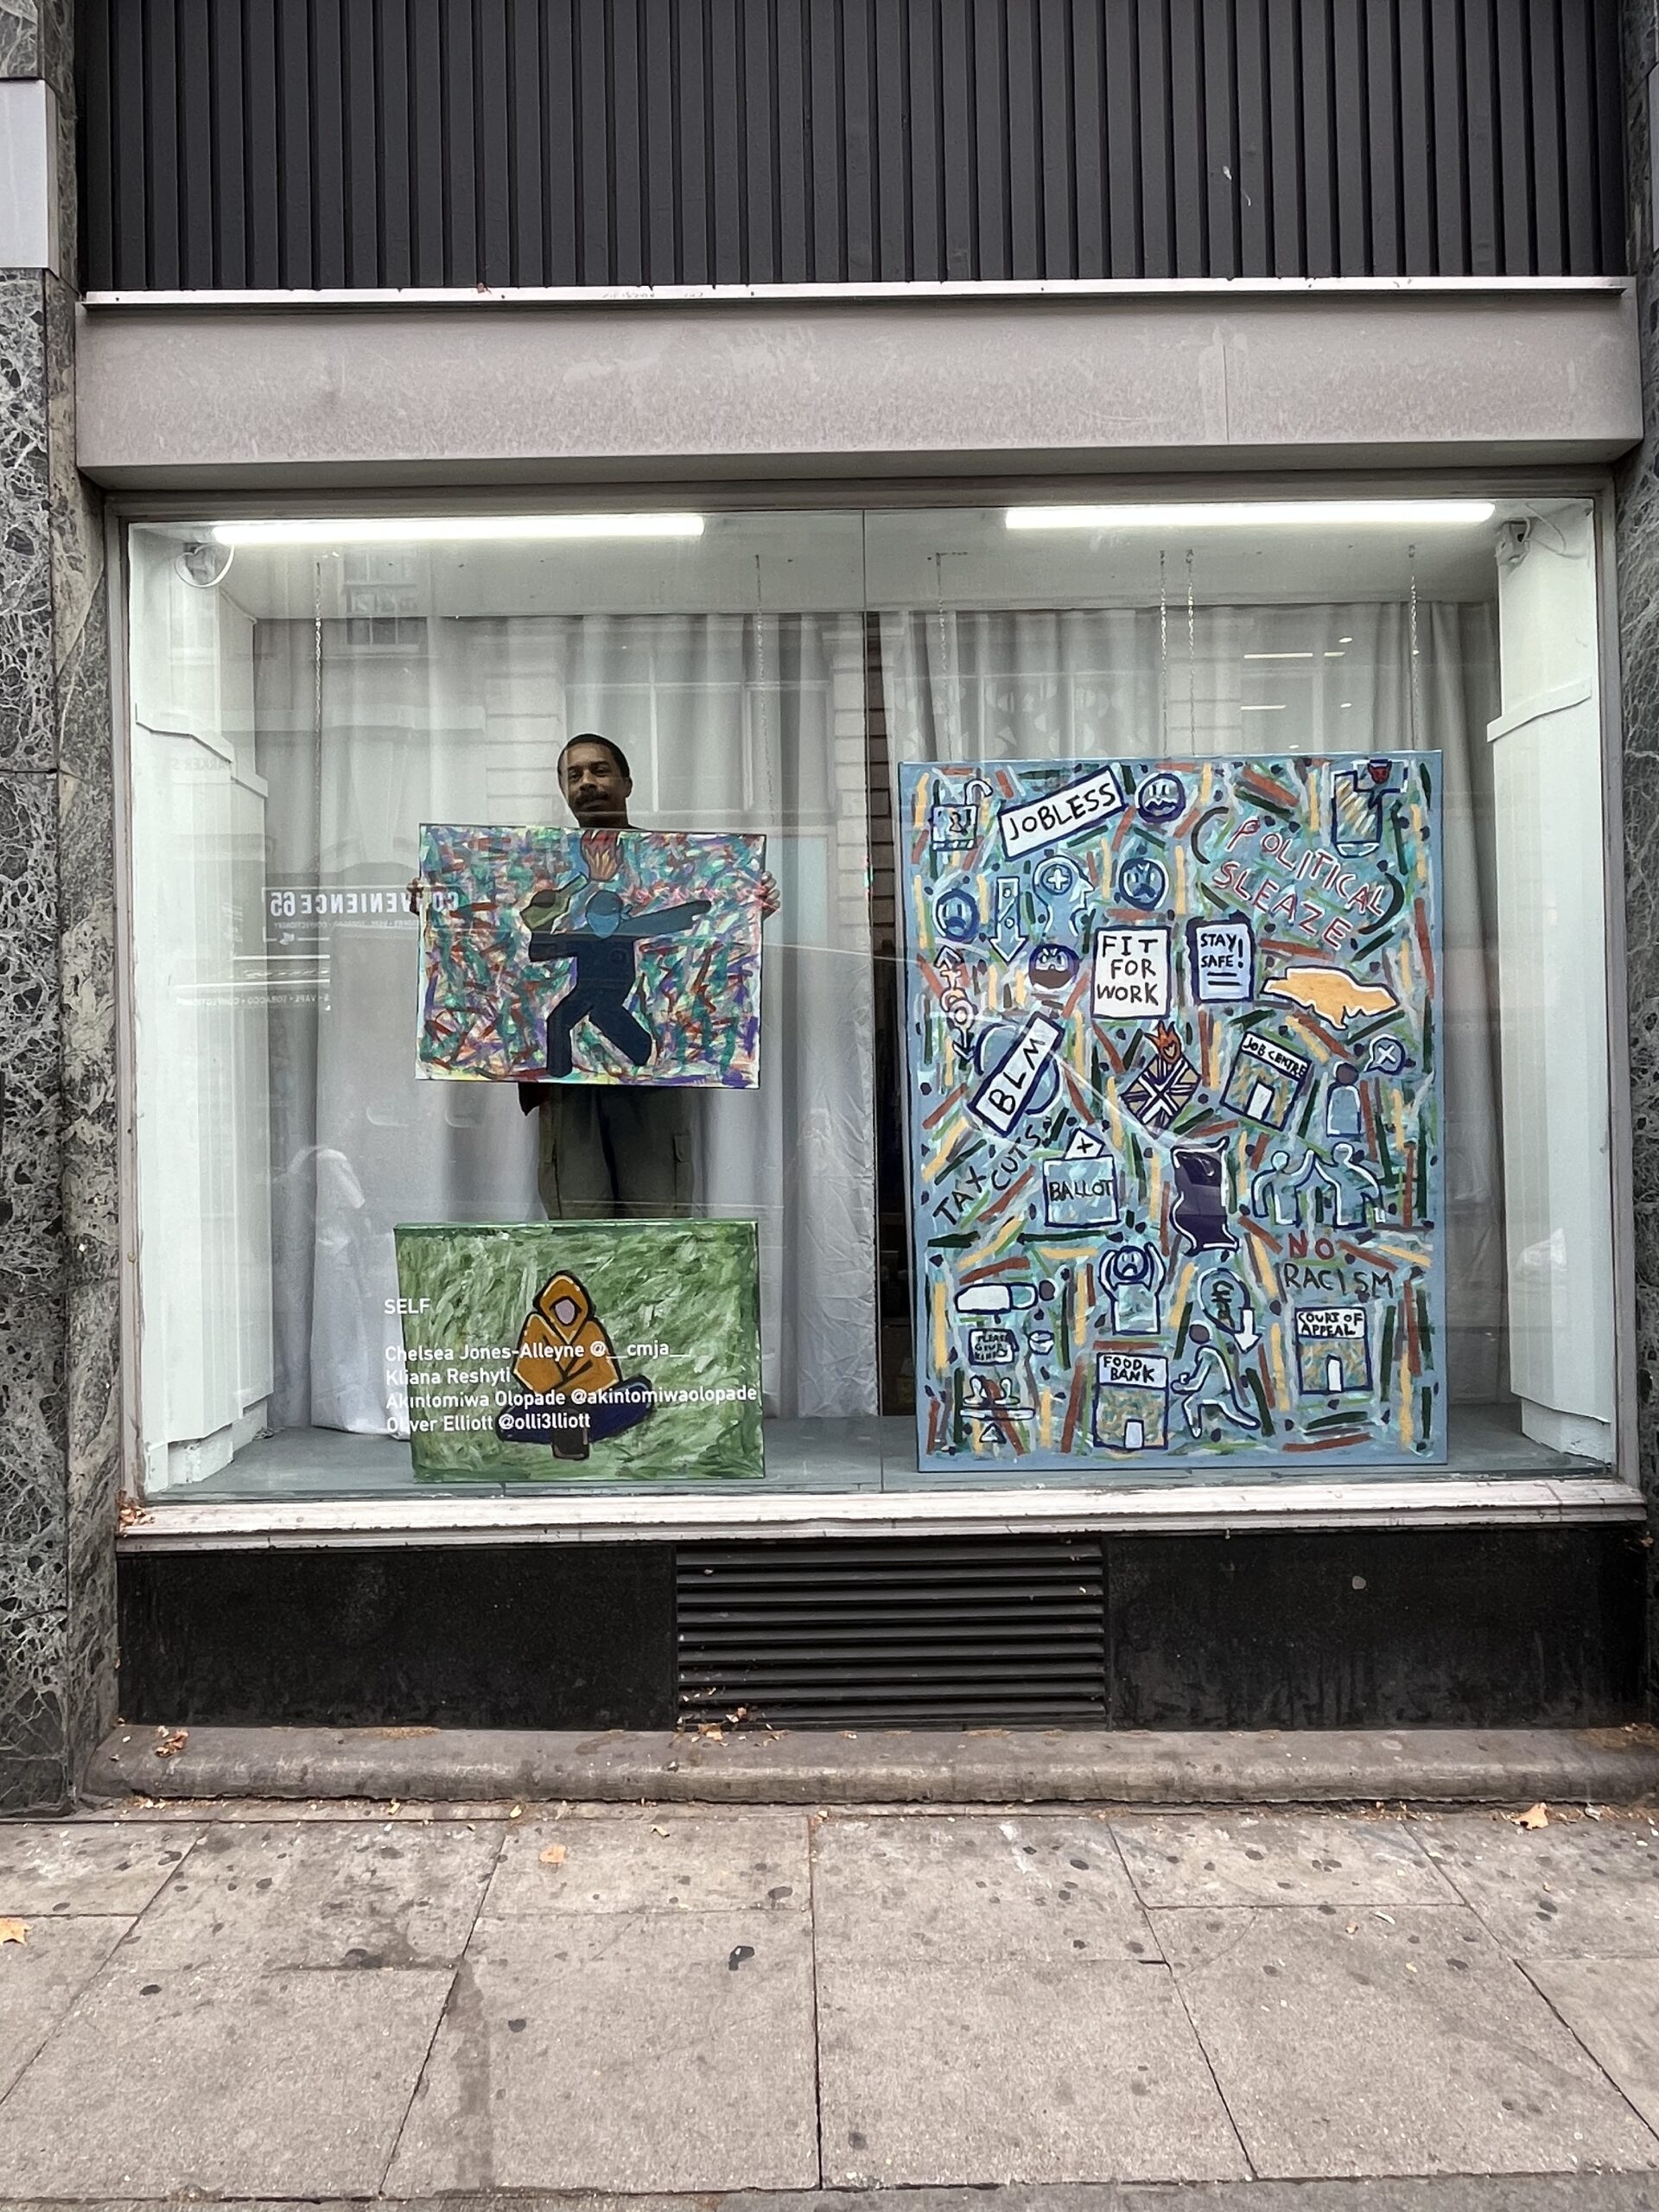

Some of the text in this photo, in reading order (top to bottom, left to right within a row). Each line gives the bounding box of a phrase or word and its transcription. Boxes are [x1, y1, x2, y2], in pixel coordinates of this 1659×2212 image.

[1010, 783, 1116, 841] JOBLESS
[1225, 817, 1384, 917] POLITICAL
[1213, 861, 1354, 950] SLEAZE
[1103, 936, 1158, 957] FIT
[1200, 934, 1236, 950] STAY
[1111, 959, 1156, 978] FOR
[1097, 982, 1159, 1006] WORK
[1243, 1038, 1307, 1077] JOB CENTRE
[988, 1038, 1046, 1116] BLM
[991, 1124, 1041, 1191] CUTS
[932, 1166, 987, 1225] TAX
[1050, 1179, 1114, 1202] BALLOT
[1287, 1229, 1335, 1260] NO
[1284, 1262, 1394, 1299] RACISM
[384, 1298, 431, 1315] SELF
[1301, 1322, 1357, 1337] APPEAL
[1344, 1313, 1363, 1326] OF
[385, 1345, 454, 1362] Chelsea
[460, 1342, 584, 1362] Jones-Alleyne
[1103, 1356, 1142, 1370] FOOD
[447, 1367, 512, 1387] Reshyti
[1110, 1363, 1154, 1382] BANK
[385, 1386, 758, 1409] Akintomiwa Olopade @akintomiwaolopade
[443, 1414, 494, 1432] Elliott
[499, 1413, 591, 1431] @olli3lliott
